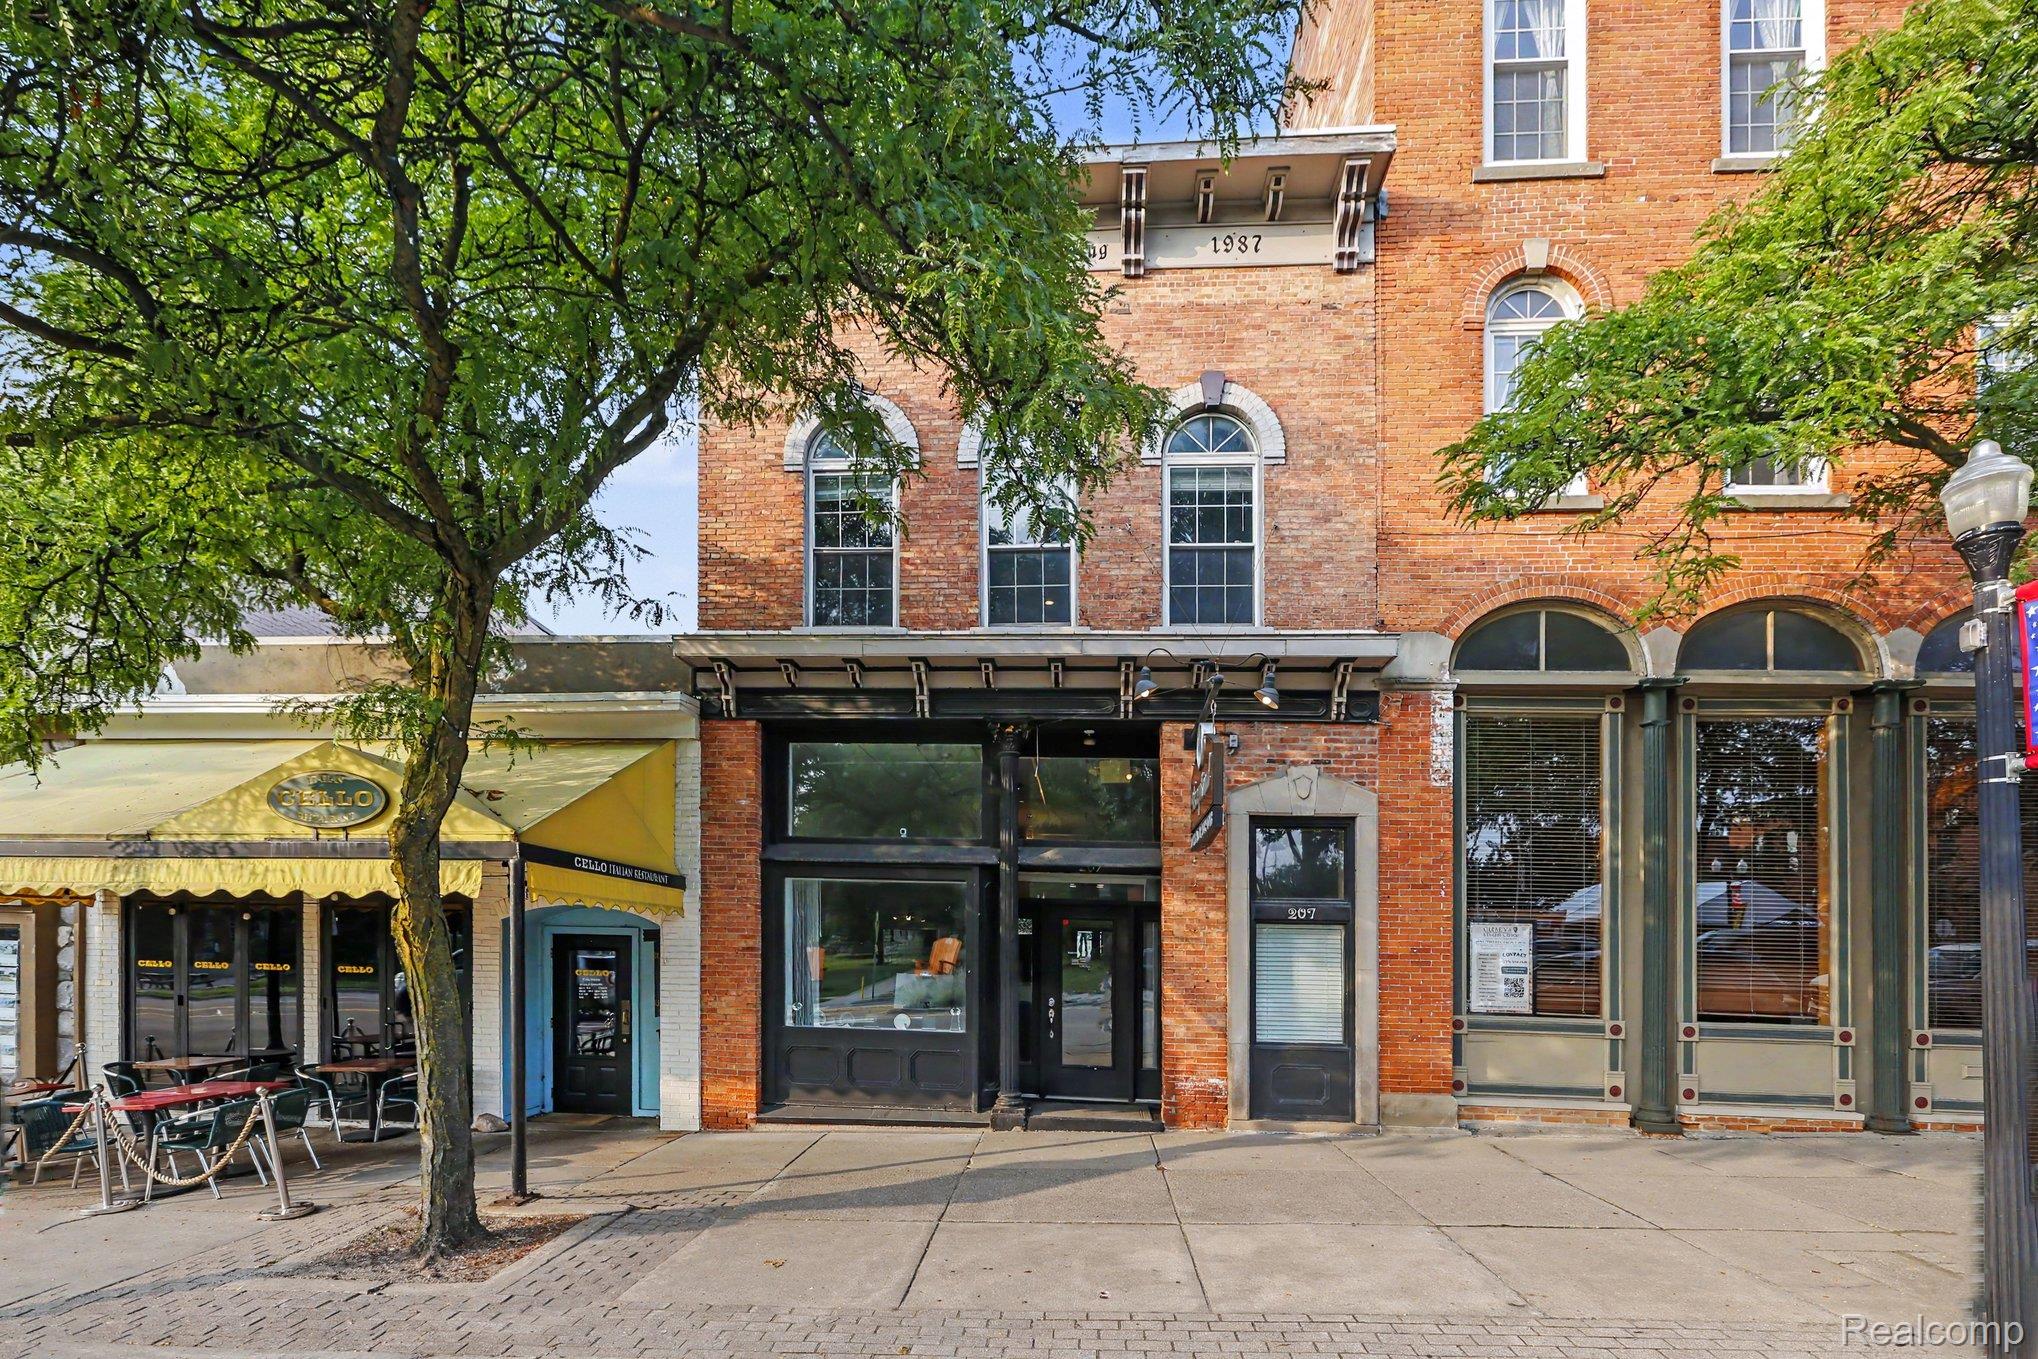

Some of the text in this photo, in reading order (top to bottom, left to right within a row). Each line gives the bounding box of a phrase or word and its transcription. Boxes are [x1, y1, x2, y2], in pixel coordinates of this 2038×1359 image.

[1211, 234, 1262, 254] 1987
[279, 790, 374, 807] CELLO
[574, 856, 668, 884] CELLO ITALIAN RESTAURANT
[1288, 907, 1316, 920] 207
[138, 960, 172, 968] CELLO
[194, 961, 229, 970] CELLO
[255, 963, 290, 971] CELLO
[337, 965, 374, 974] CELLO
